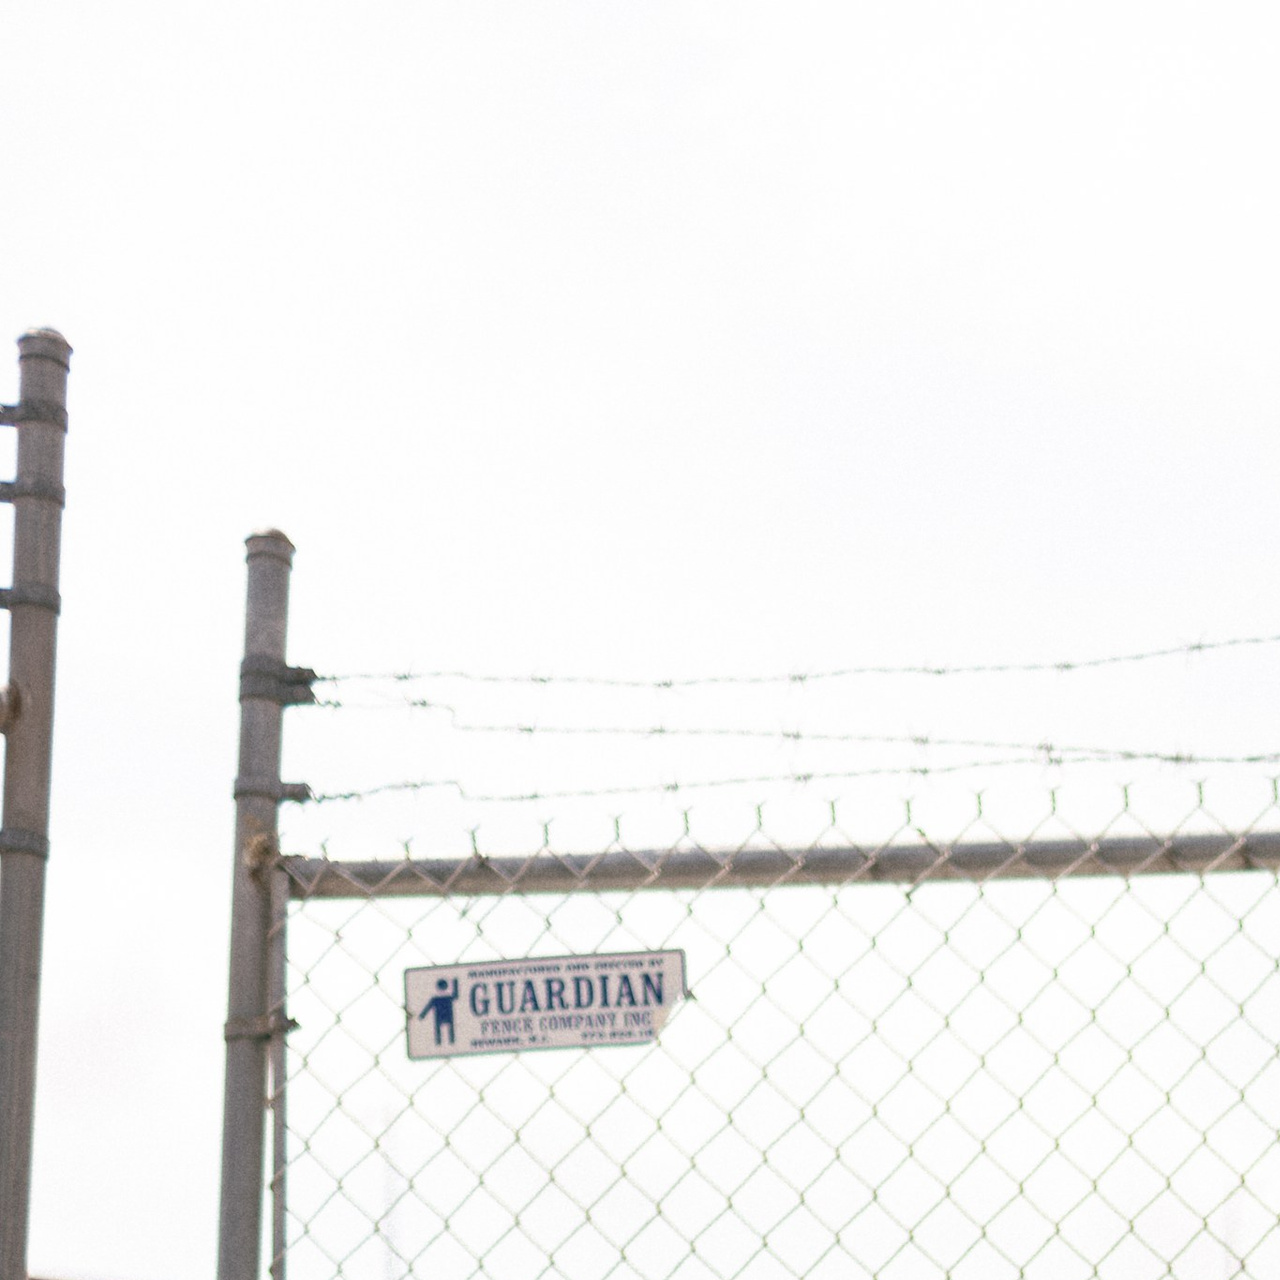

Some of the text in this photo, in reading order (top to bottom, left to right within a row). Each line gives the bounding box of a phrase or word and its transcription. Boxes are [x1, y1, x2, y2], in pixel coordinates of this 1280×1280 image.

[469, 972, 665, 1016] GUARDIAN
[480, 1016, 534, 1035] FENCE
[539, 1012, 617, 1032] COMPANY
